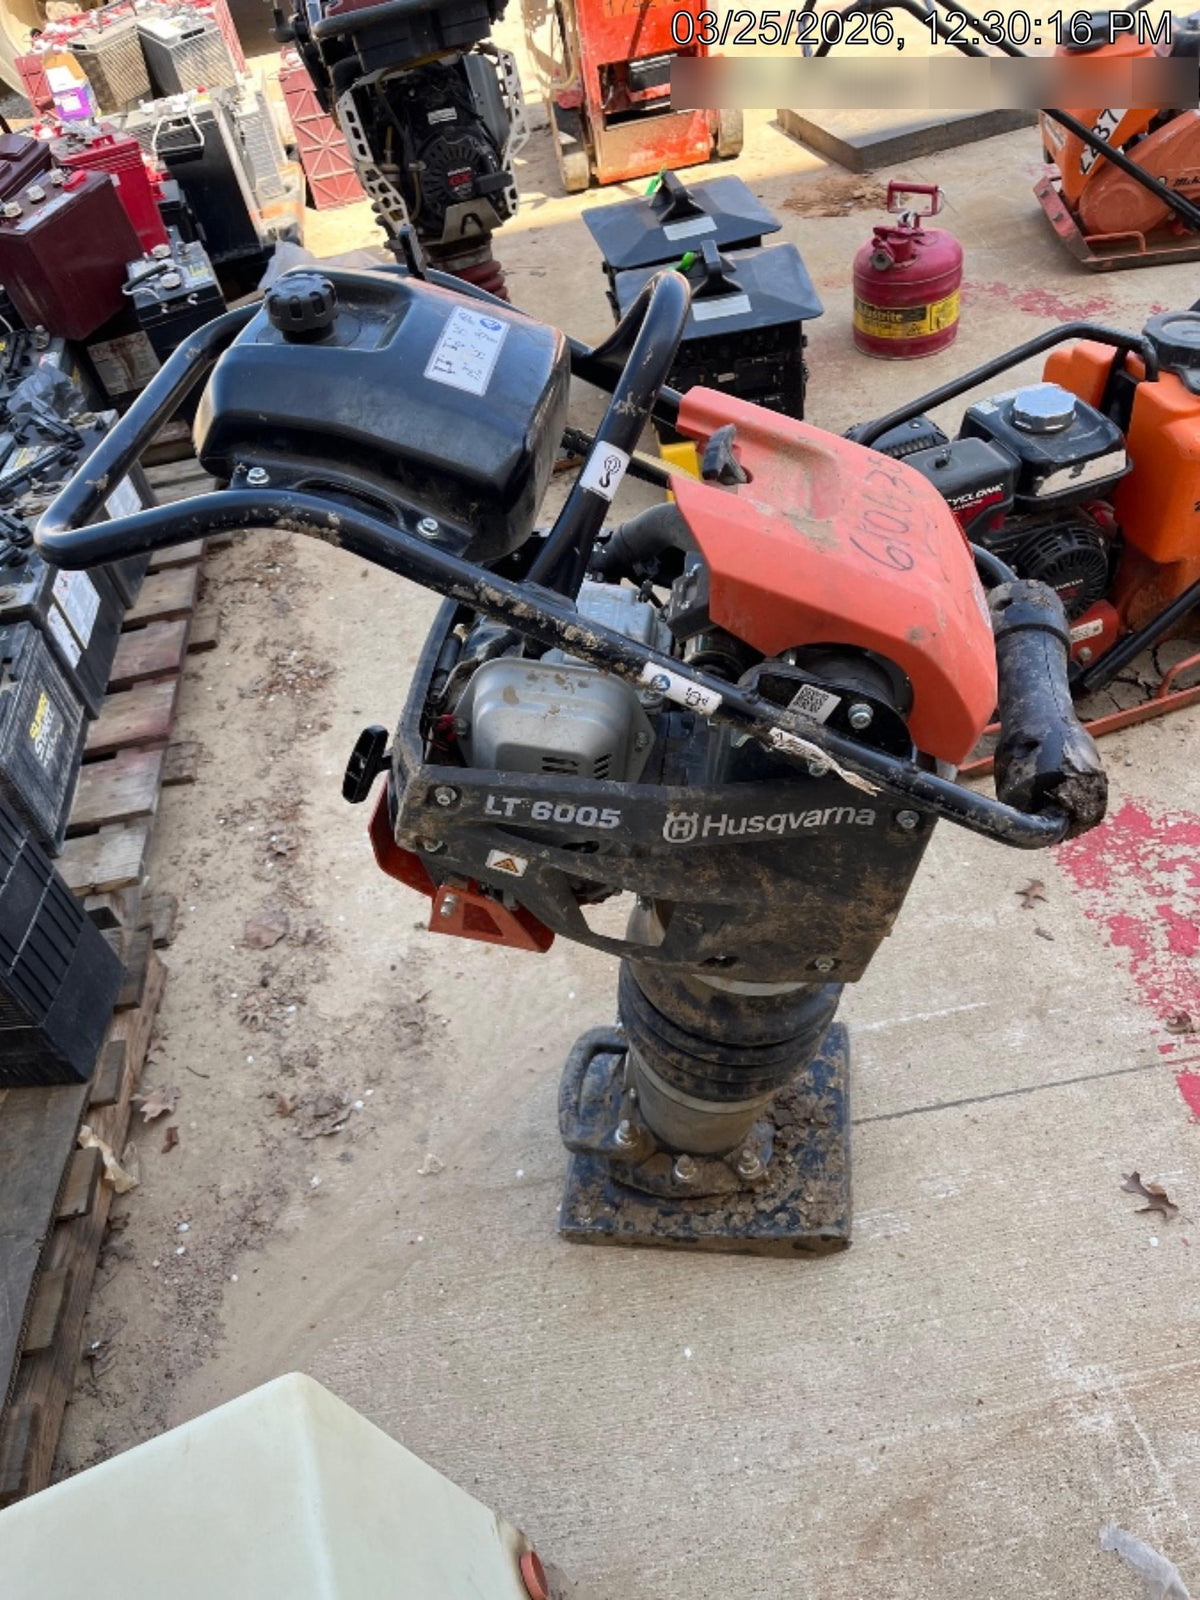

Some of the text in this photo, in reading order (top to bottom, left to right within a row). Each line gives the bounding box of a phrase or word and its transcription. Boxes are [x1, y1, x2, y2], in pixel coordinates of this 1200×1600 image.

[484, 794, 621, 829] LT 6005
[702, 806, 876, 837] Husqvarna
